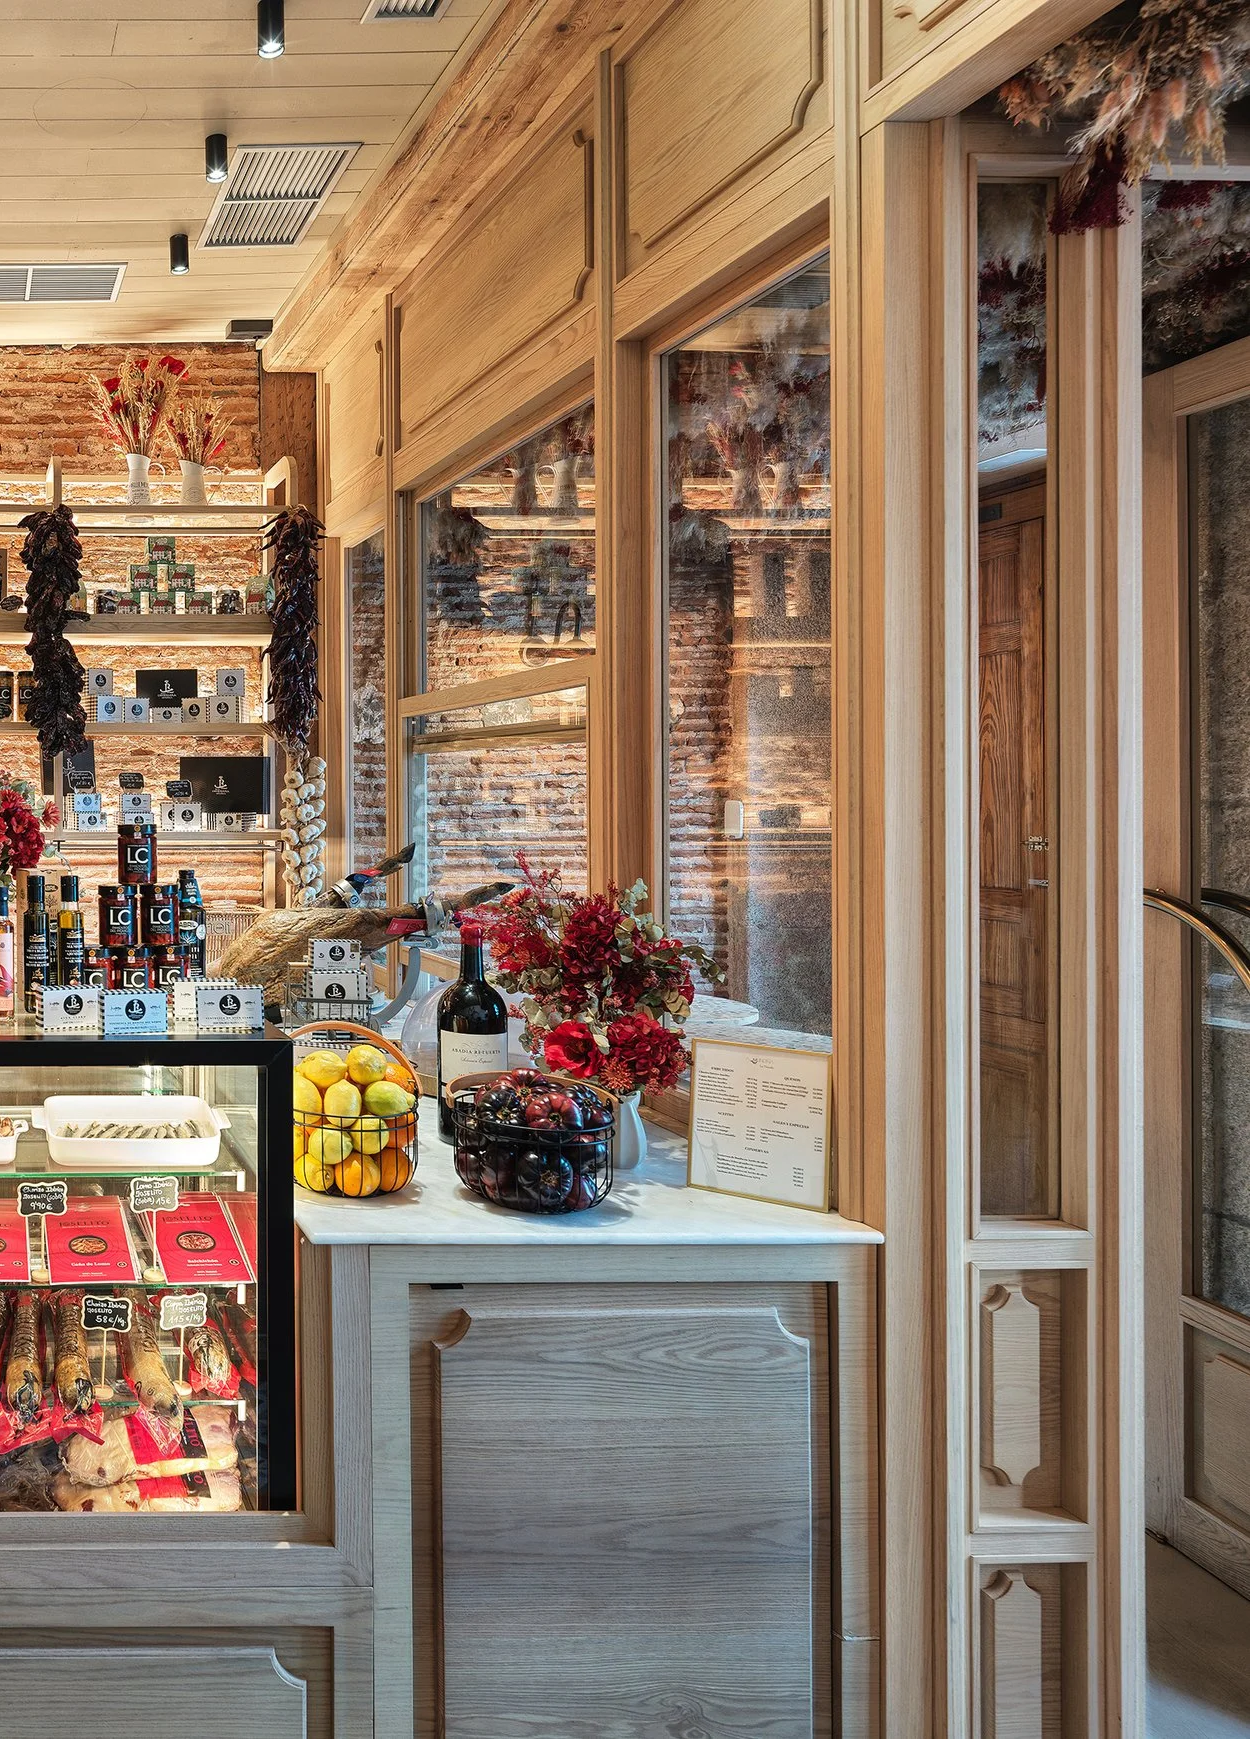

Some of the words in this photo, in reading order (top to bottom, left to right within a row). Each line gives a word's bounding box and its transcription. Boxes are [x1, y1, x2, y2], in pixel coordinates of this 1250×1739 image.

[127, 847, 149, 864] LC
[110, 909, 131, 926] LC
[150, 908, 171, 924] LC
[123, 971, 145, 988] LC
[159, 968, 180, 985] LC
